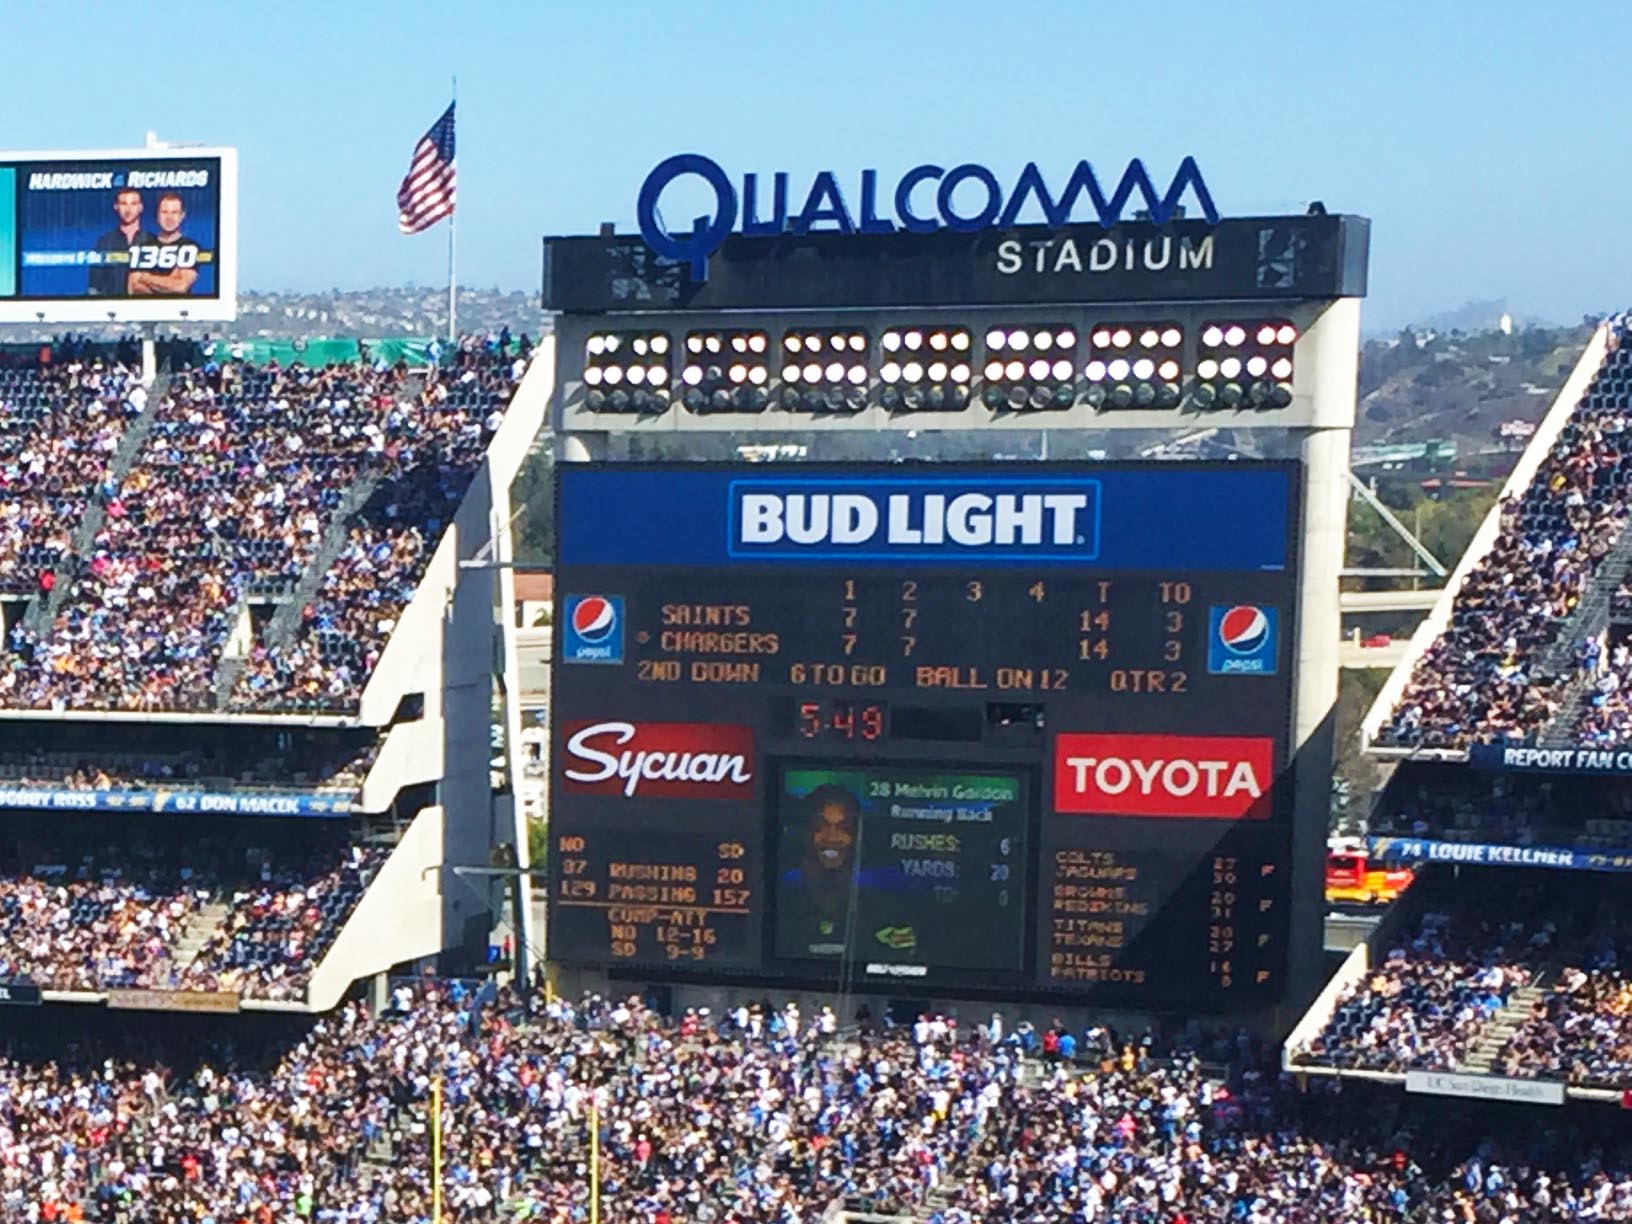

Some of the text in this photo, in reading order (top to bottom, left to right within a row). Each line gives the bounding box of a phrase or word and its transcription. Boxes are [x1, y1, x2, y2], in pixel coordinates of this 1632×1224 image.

[28, 172, 112, 190] HARDWICK
[128, 170, 209, 188] RICHARDS
[637, 153, 1220, 282] QUALCOMM
[128, 244, 199, 269] 1360
[995, 233, 1216, 275] STADIUM
[741, 492, 1087, 547] BUD LIGHT
[844, 580, 1192, 604] 1 2 3 4 T TO
[660, 604, 1183, 633] SAINTS 7 7 14 3
[660, 631, 1182, 661] CHARGERS 7 7 14 3
[637, 659, 1188, 693] 2ND DOWN 6 TO GO BALL ON 12 QTR 2
[564, 722, 752, 797] Sycuan
[1503, 748, 1612, 769] REPORT FAN
[1066, 756, 1262, 799] TOYOTA
[54, 791, 97, 808] ROSS
[895, 782, 948, 799] Melvin
[952, 784, 1014, 801] Gordon
[200, 795, 237, 812] DON
[239, 797, 300, 814] MACEK
[890, 803, 953, 824] Running
[558, 836, 586, 852] NO
[717, 842, 745, 859] SD
[1428, 842, 1484, 861] LOUIE
[1055, 850, 1115, 866] COLTS
[608, 862, 744, 884] RUSHING 20
[561, 880, 752, 905] 129 PASSING 157
[1050, 952, 1112, 968] BILLS
[1050, 967, 1146, 984] PATRIOTS
